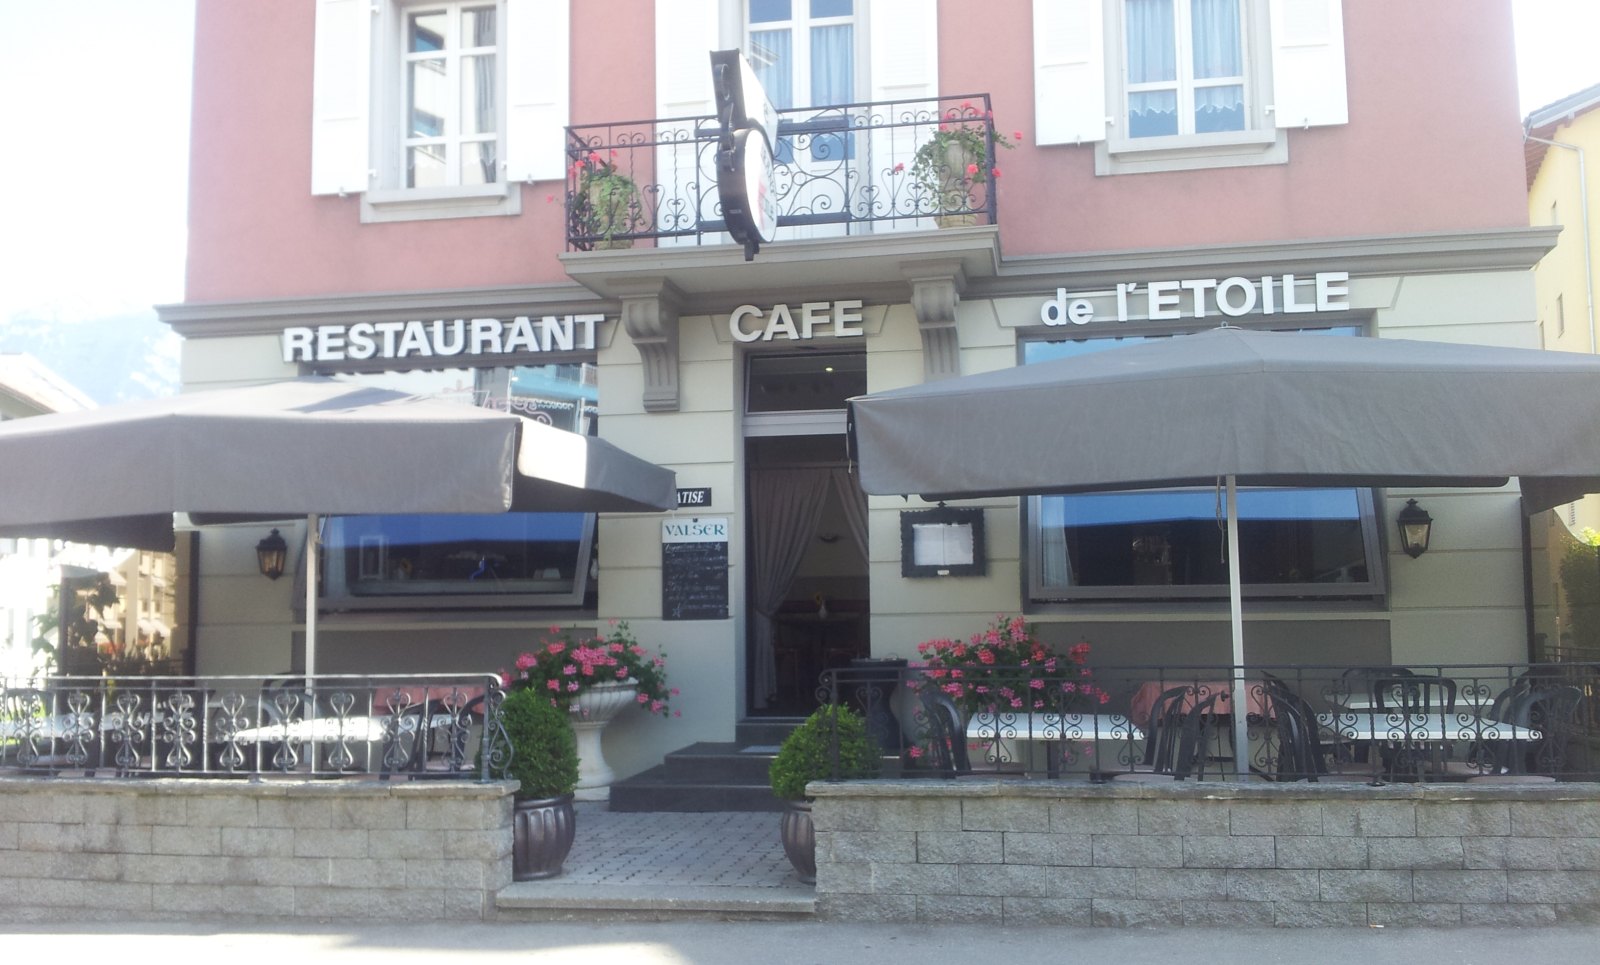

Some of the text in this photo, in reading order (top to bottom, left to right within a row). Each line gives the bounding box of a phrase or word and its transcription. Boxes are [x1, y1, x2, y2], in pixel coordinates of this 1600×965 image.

[729, 300, 864, 342] CAFE
[1041, 272, 1350, 326] de l'ETOILE
[283, 314, 604, 362] RESTAURANT
